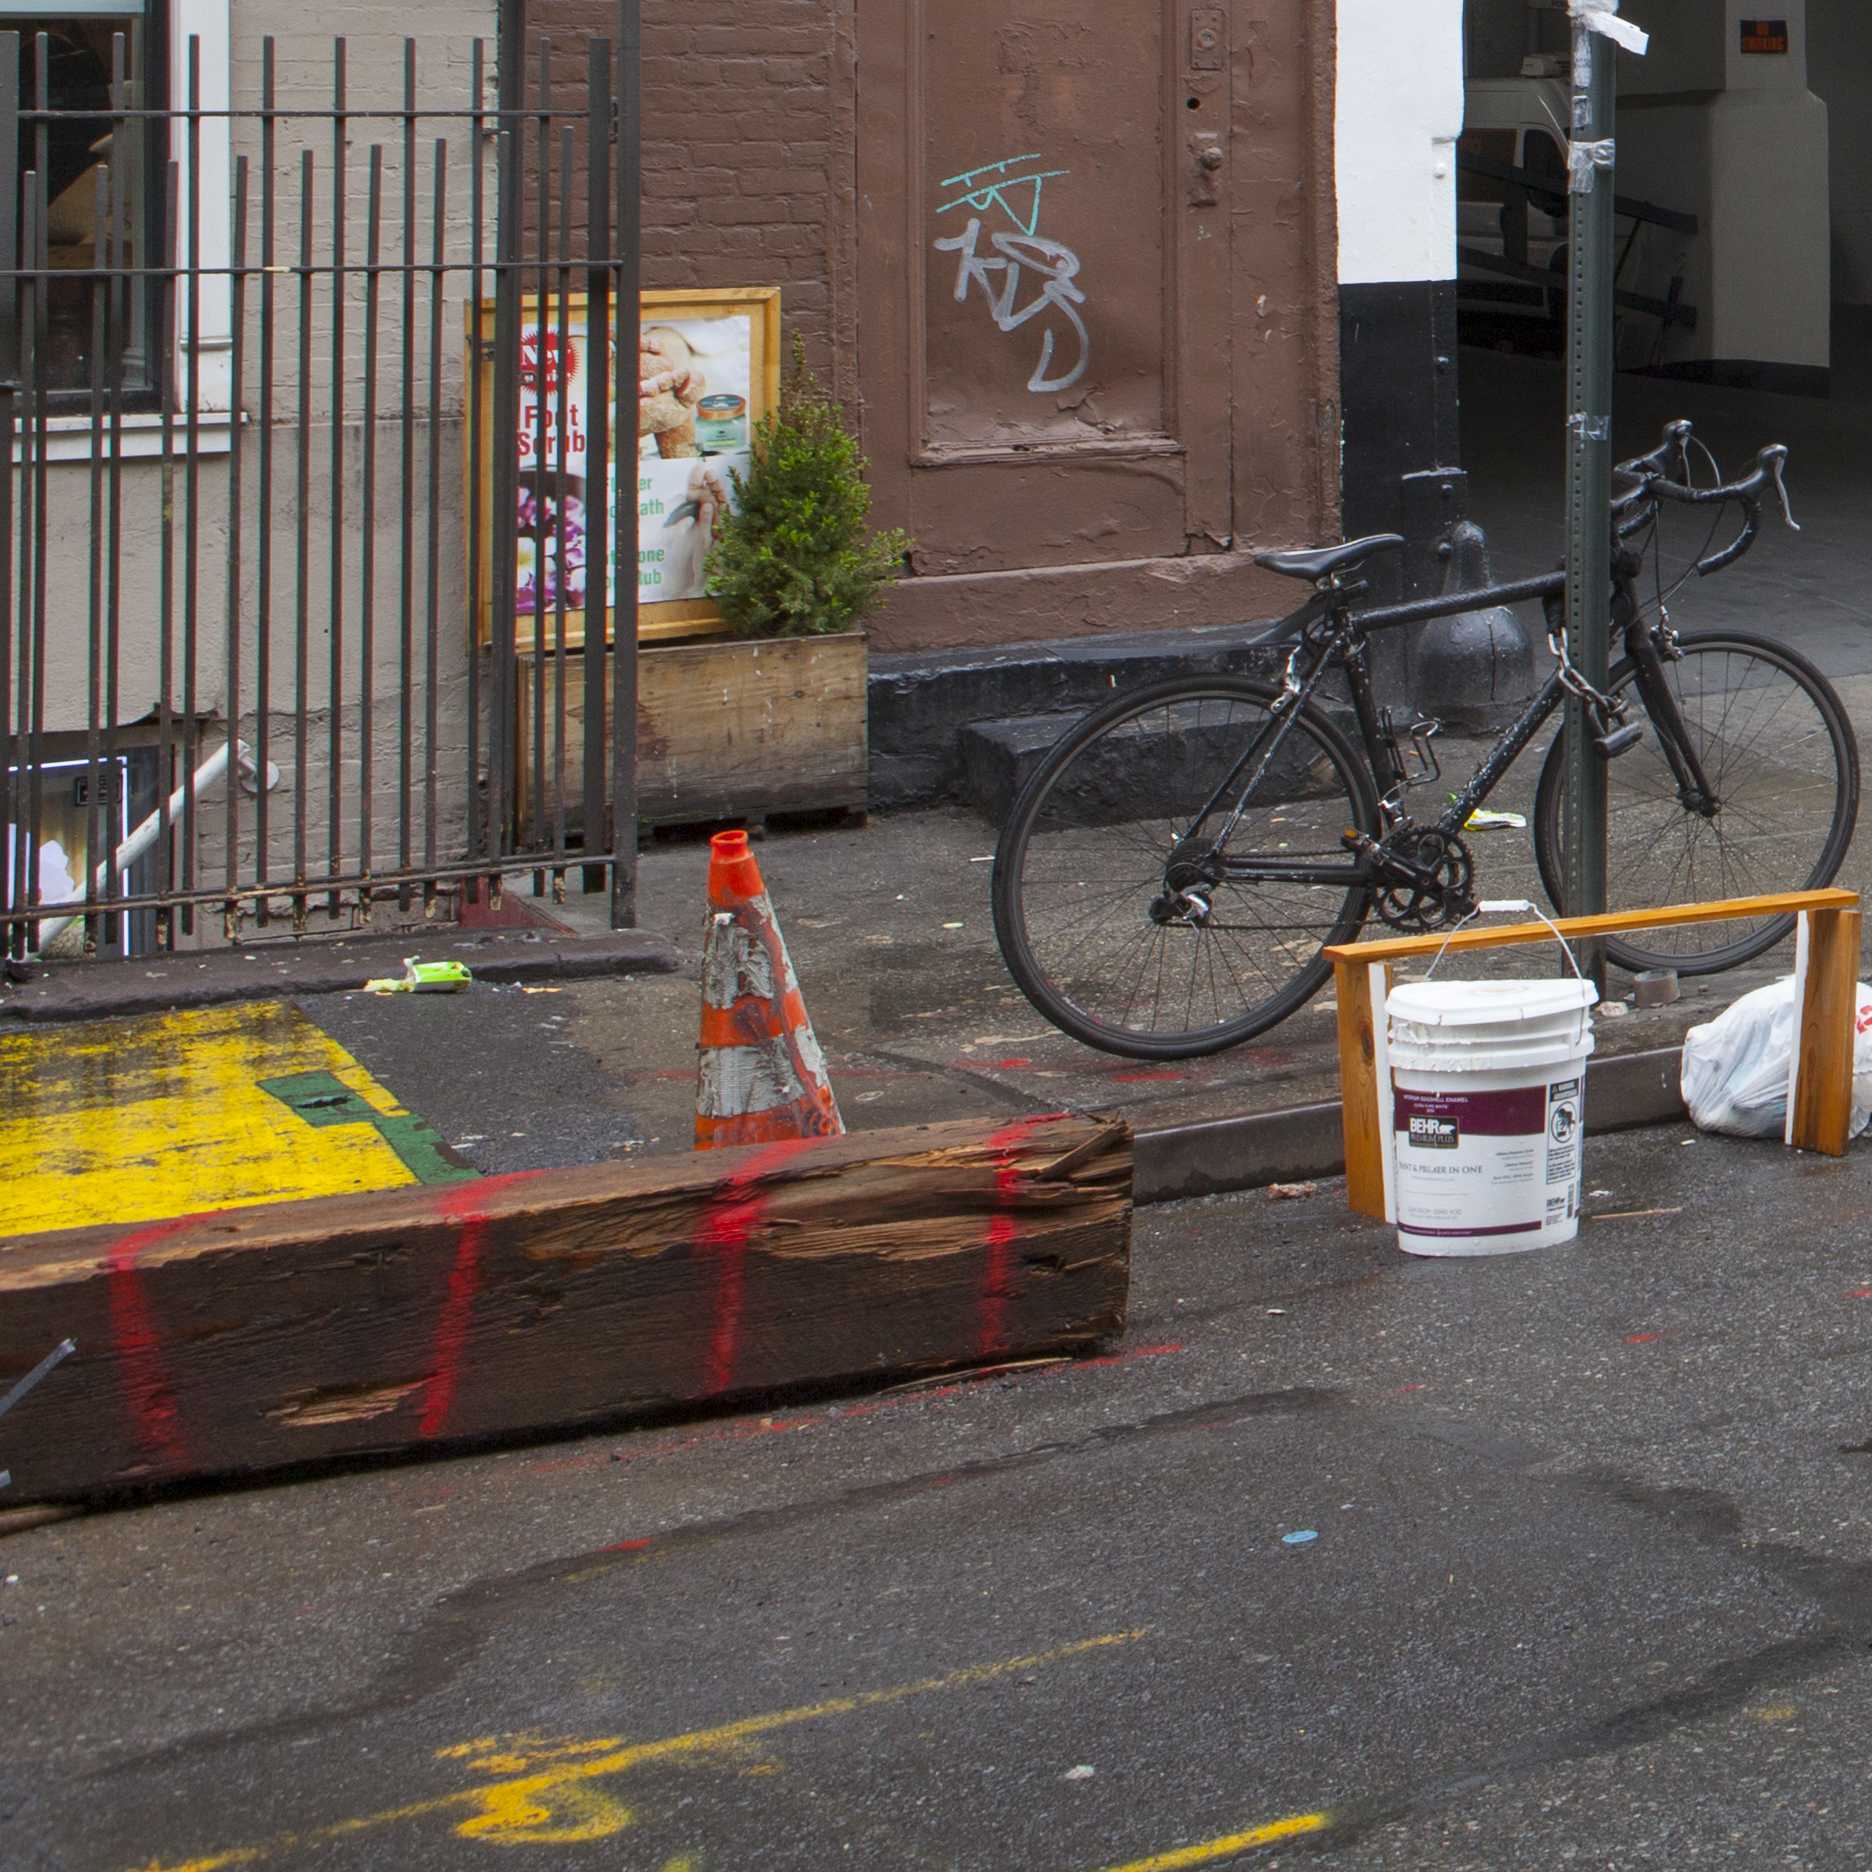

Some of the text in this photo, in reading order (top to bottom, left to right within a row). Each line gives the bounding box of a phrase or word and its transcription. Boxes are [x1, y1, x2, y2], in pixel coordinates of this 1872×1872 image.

[524, 404, 579, 429] Fot
[1410, 1117, 1440, 1134] BEHR
[1461, 1164, 1483, 1175] ONE
